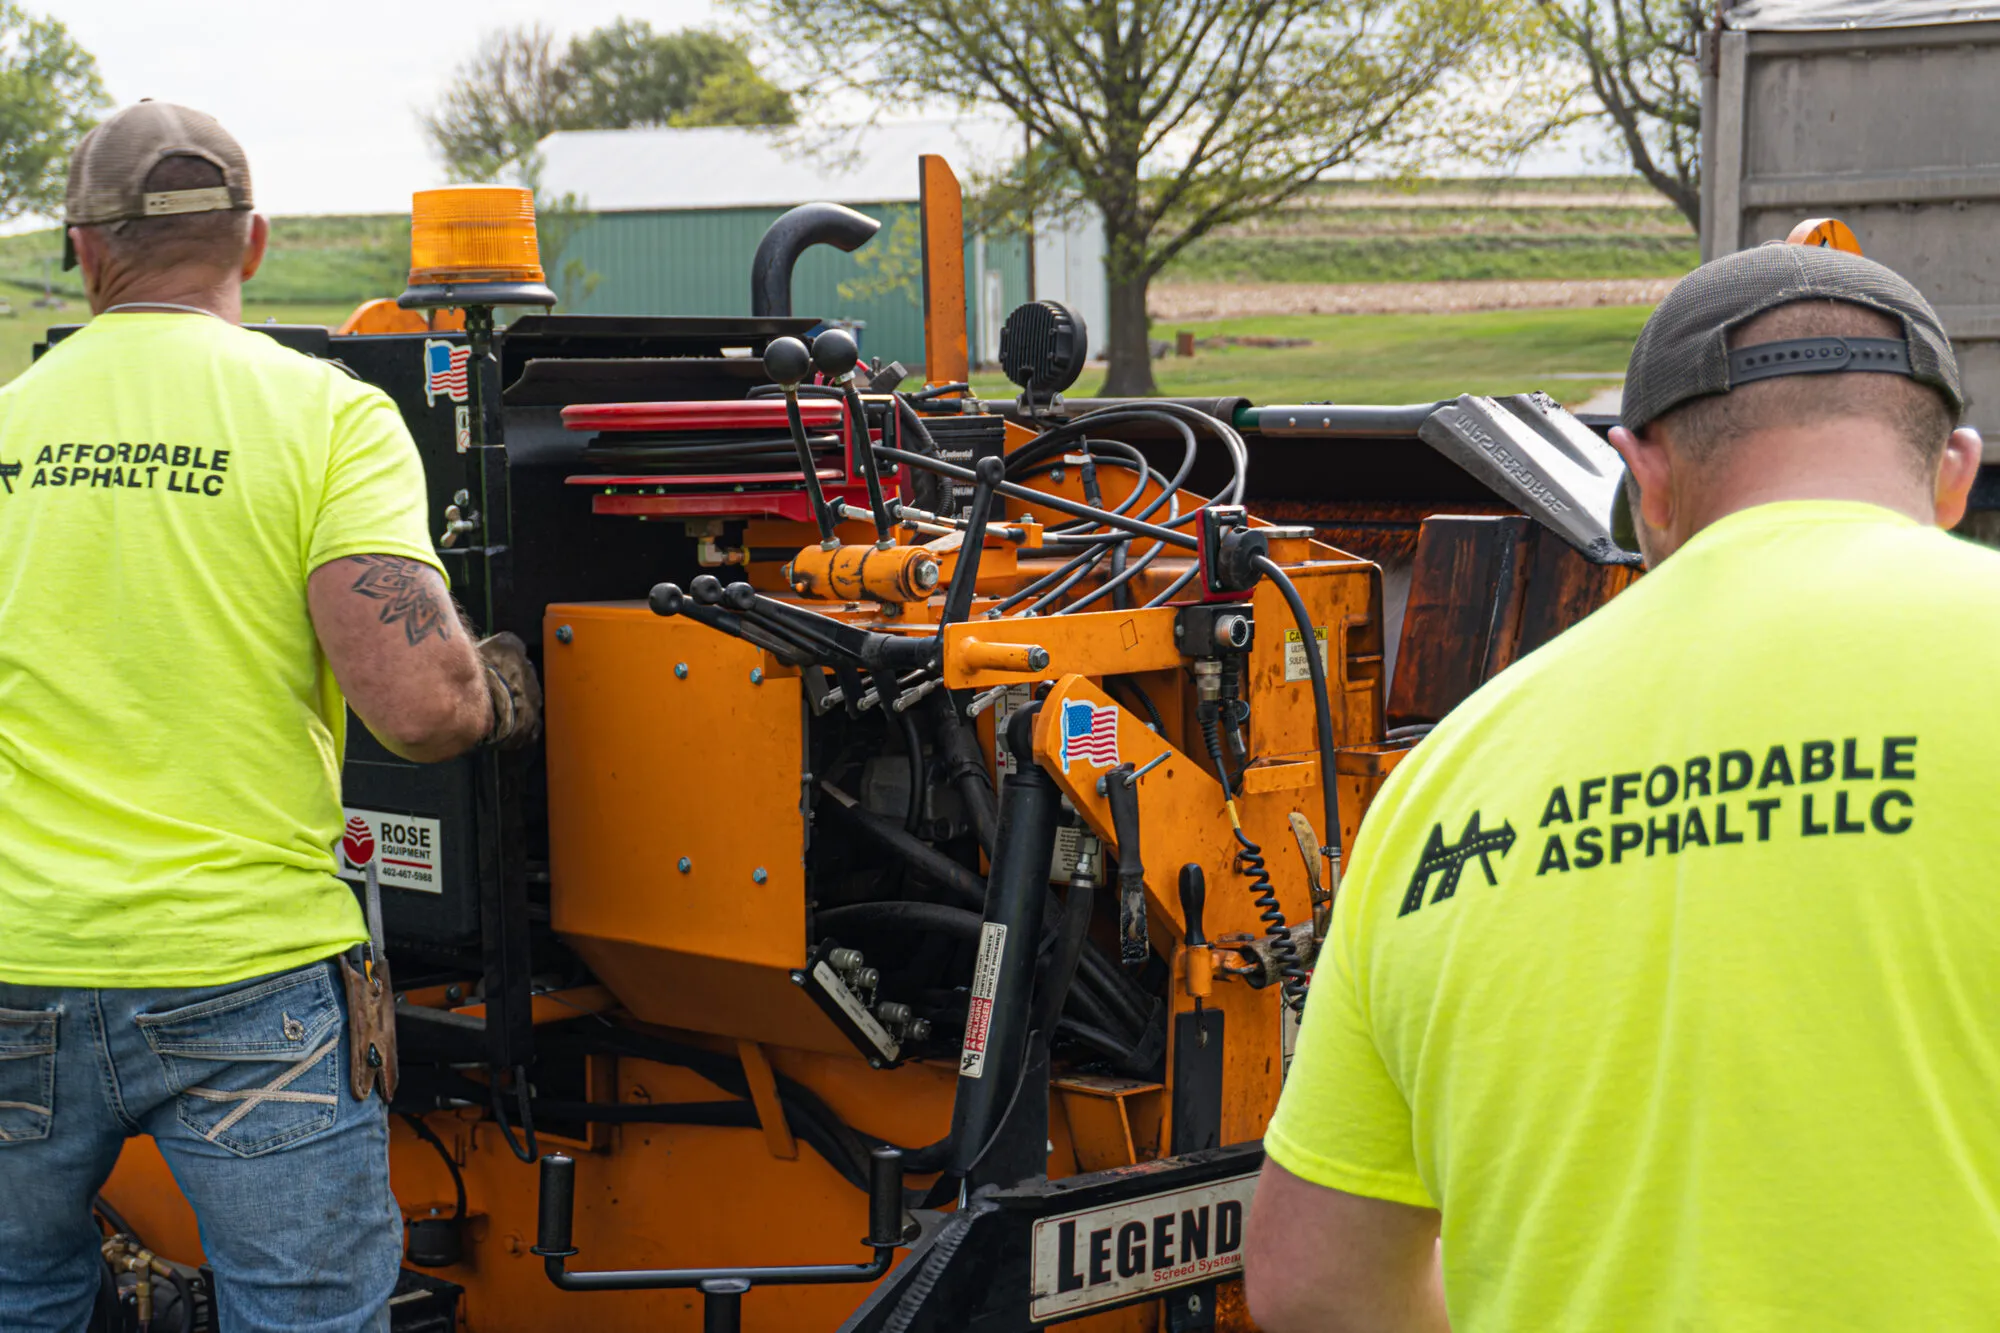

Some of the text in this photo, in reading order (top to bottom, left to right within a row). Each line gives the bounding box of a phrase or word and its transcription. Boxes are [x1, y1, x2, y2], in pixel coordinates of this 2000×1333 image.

[35, 442, 231, 472] AFFORDABLE
[30, 465, 224, 497] ASPHALT LLC
[1538, 736, 1918, 828] AFFORDABLE
[381, 822, 431, 848] ROSE
[1536, 789, 1915, 876] ASPHALT LLC
[381, 844, 431, 860] EQUIPMENT
[989, 964, 995, 976] DE
[986, 976, 994, 998] POINT
[971, 999, 983, 1040] PELIGRO
[977, 1002, 991, 1041] DANGER
[1153, 1261, 1196, 1282] Screed
